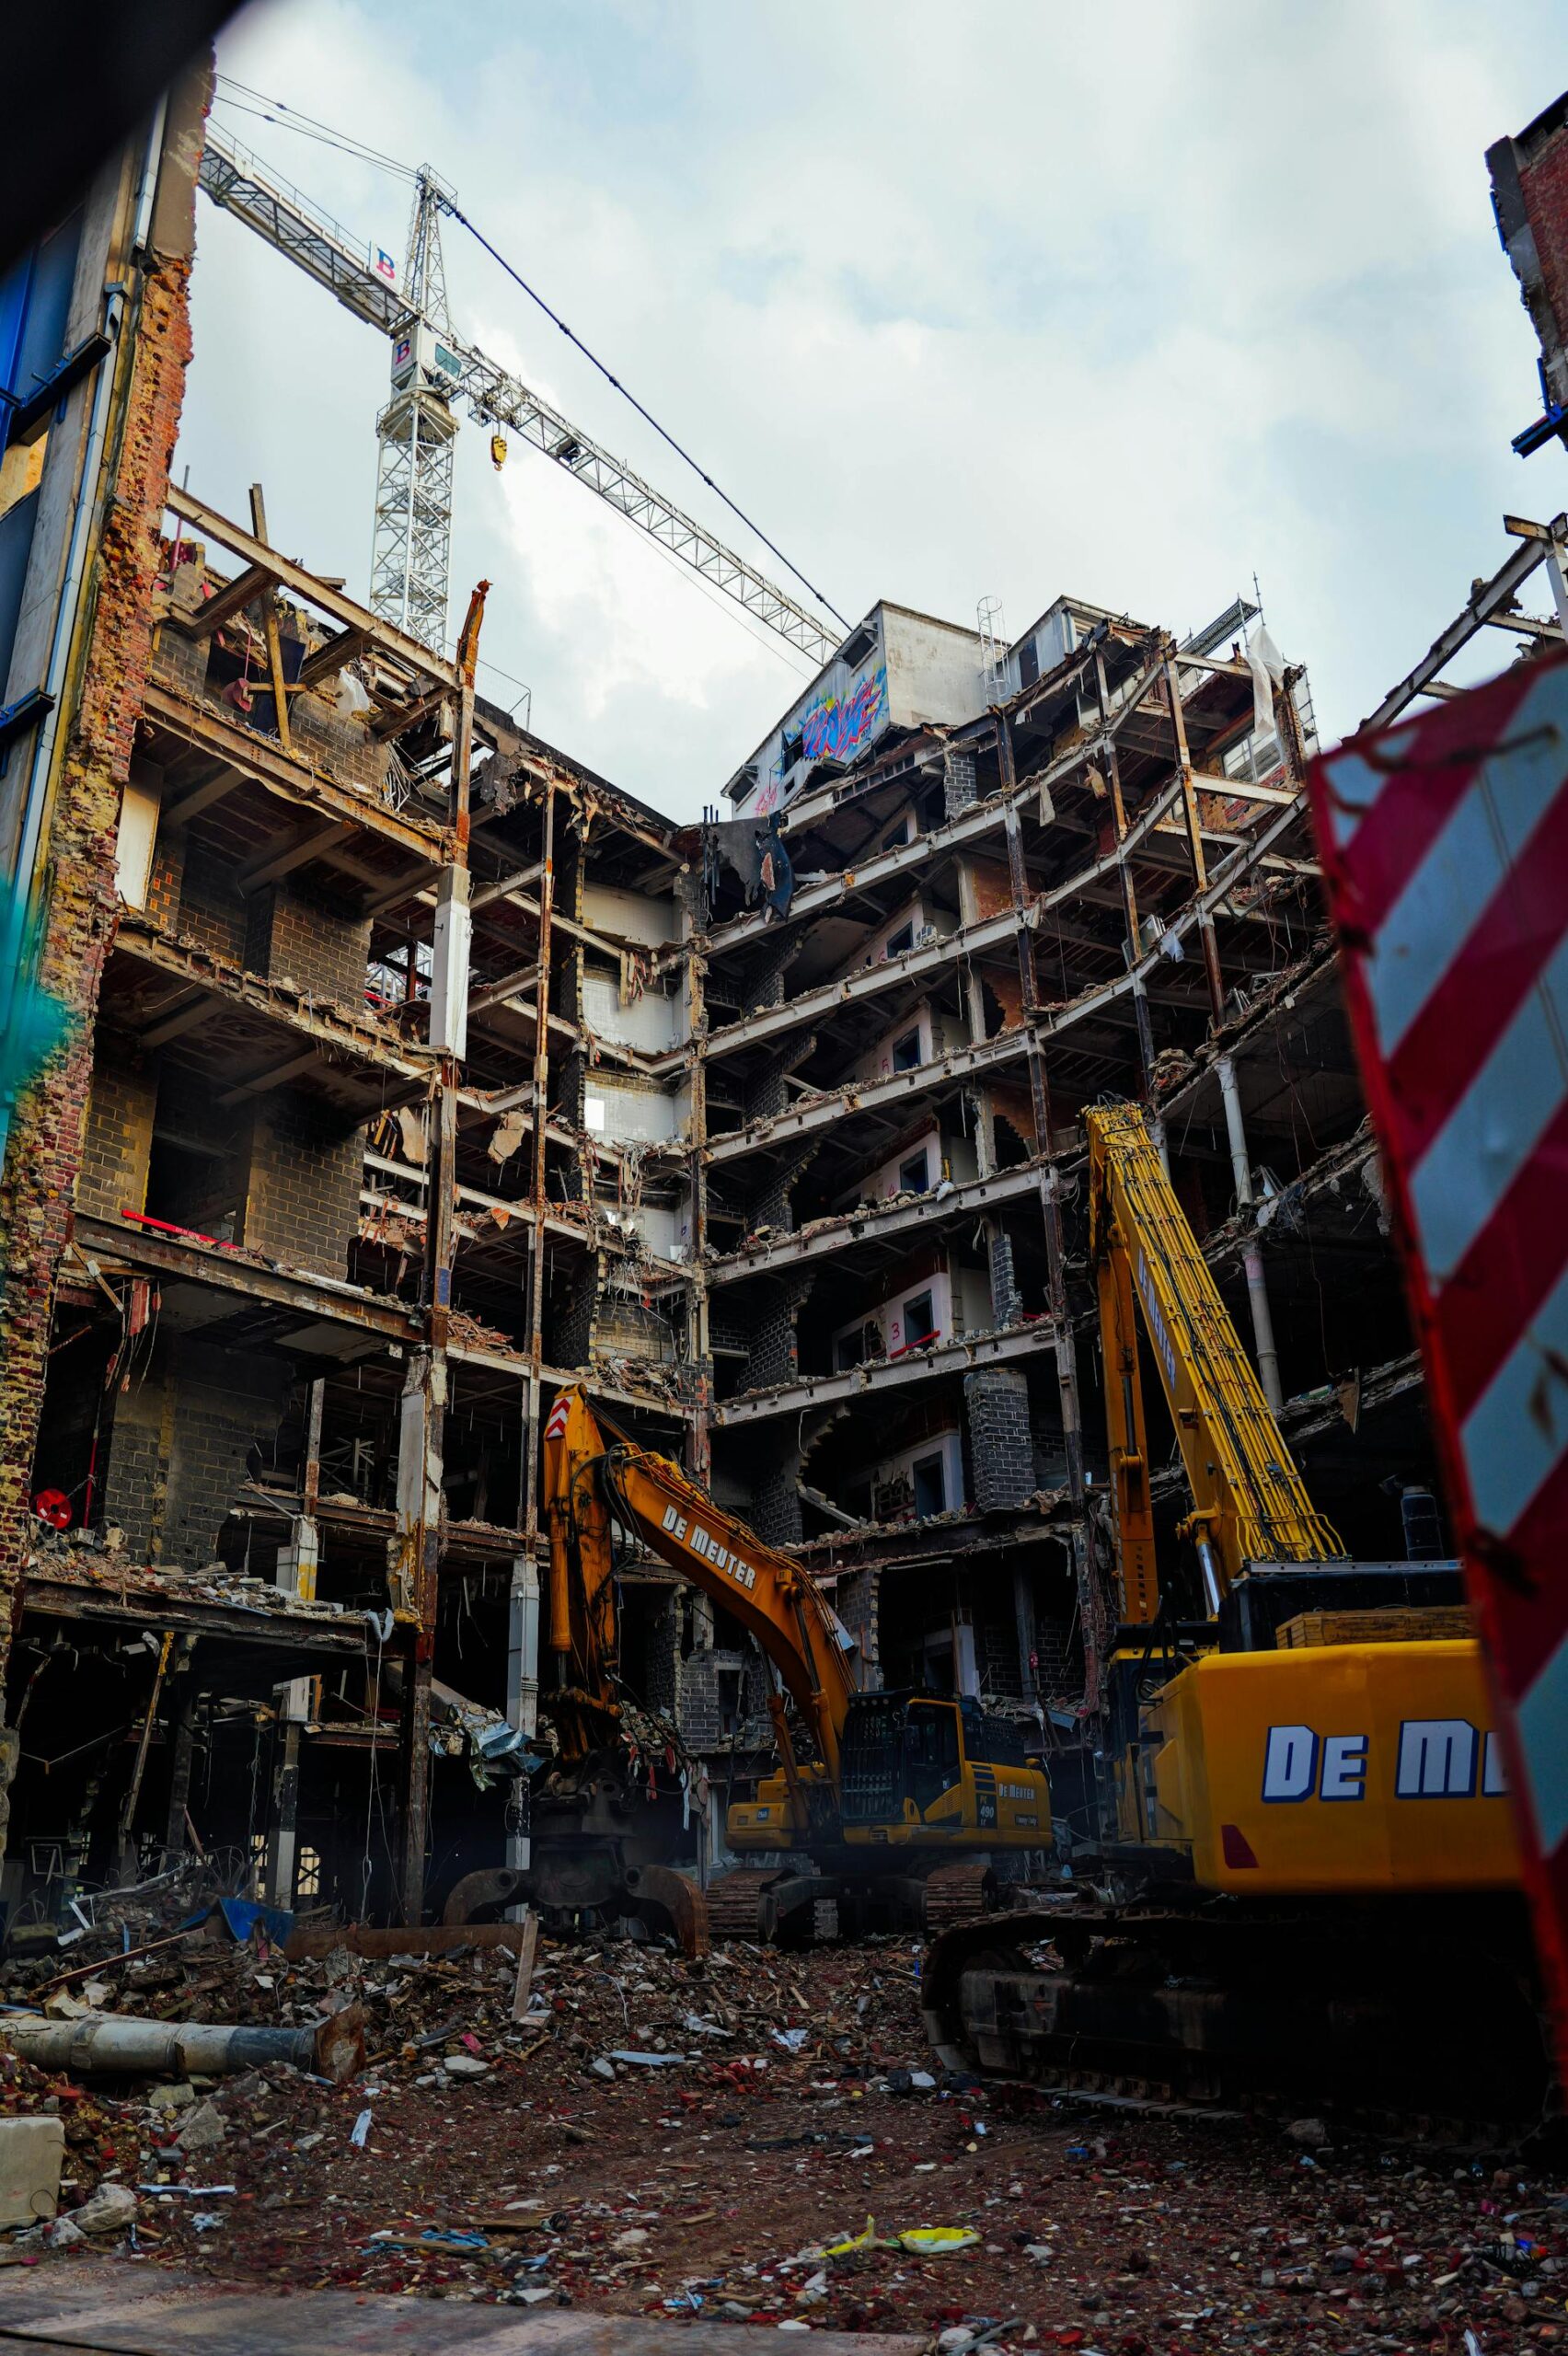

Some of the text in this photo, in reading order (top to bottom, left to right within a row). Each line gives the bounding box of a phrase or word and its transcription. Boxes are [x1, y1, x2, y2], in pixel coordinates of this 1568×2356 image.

[376, 247, 396, 280] B
[396, 339, 410, 365] B
[892, 1322, 900, 1341] 3
[662, 1504, 756, 1591] DE MEUTER
[1262, 1725, 1369, 1803] DE
[1009, 1784, 1035, 1800] MEUTER
[980, 1806, 994, 1819] 490
